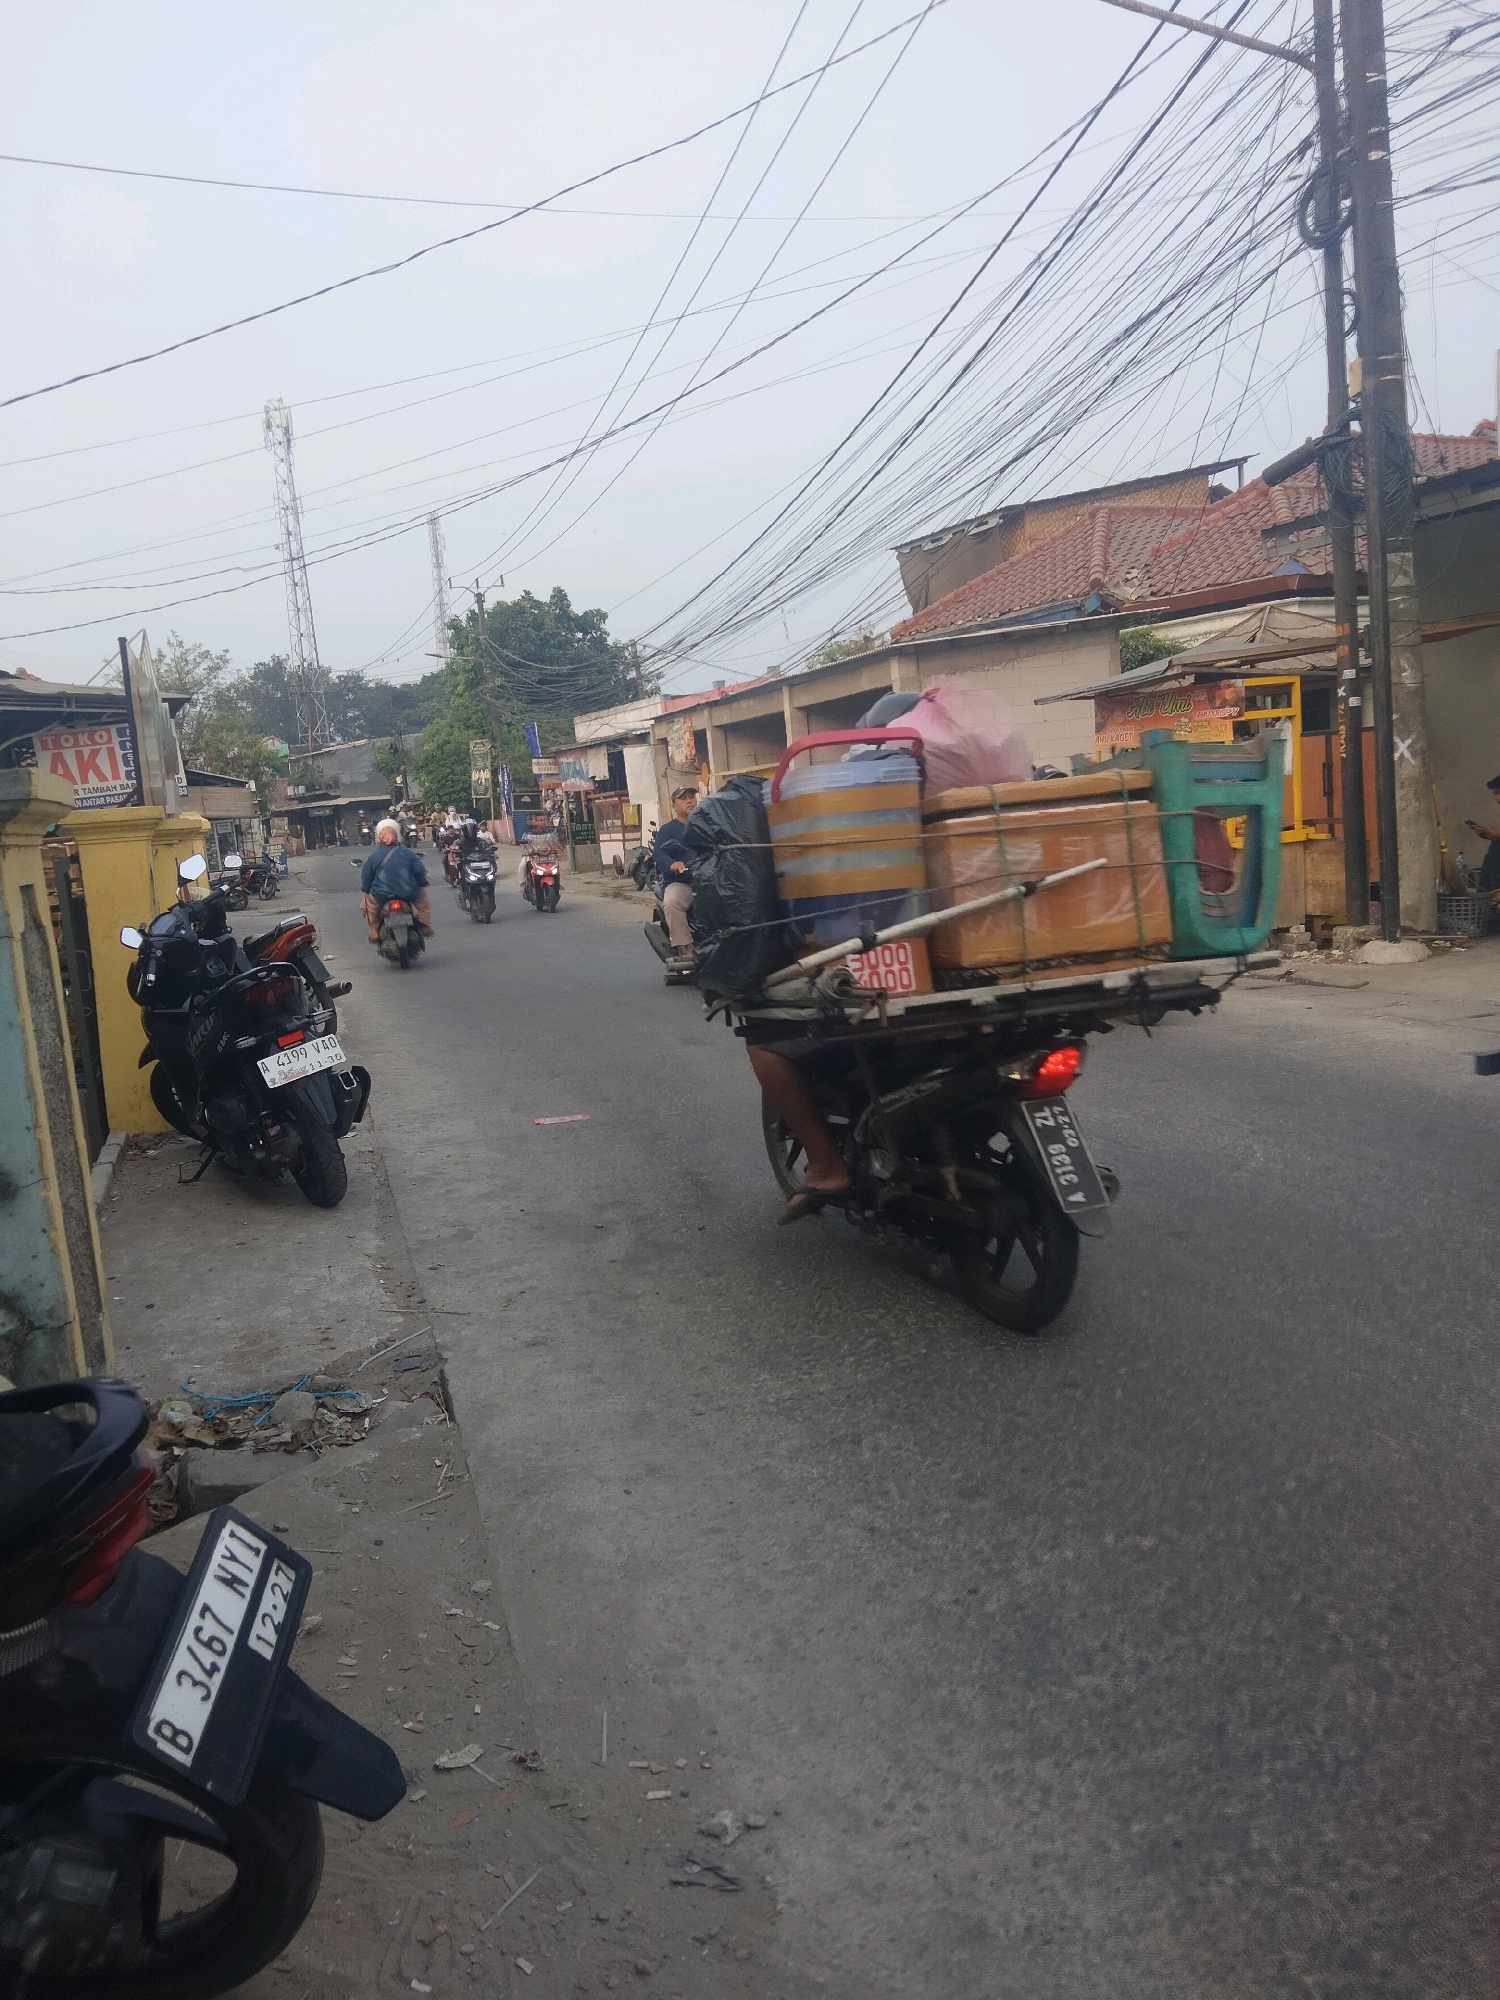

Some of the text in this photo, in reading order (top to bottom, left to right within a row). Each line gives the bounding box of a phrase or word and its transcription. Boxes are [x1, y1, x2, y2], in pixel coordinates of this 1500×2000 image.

[1158, 690, 1194, 715] Umi
[43, 730, 108, 749] TOKO
[50, 746, 122, 785] AKI
[81, 785, 117, 795] TAMBAH
[82, 796, 105, 807] ANTAR
[260, 1061, 270, 1075] A
[276, 1047, 308, 1068] 4199
[312, 1037, 338, 1055] VAO
[1033, 1106, 1056, 1129] ZL
[1066, 1191, 1088, 1203] A
[153, 1529, 262, 1756] B 3467 NYI
